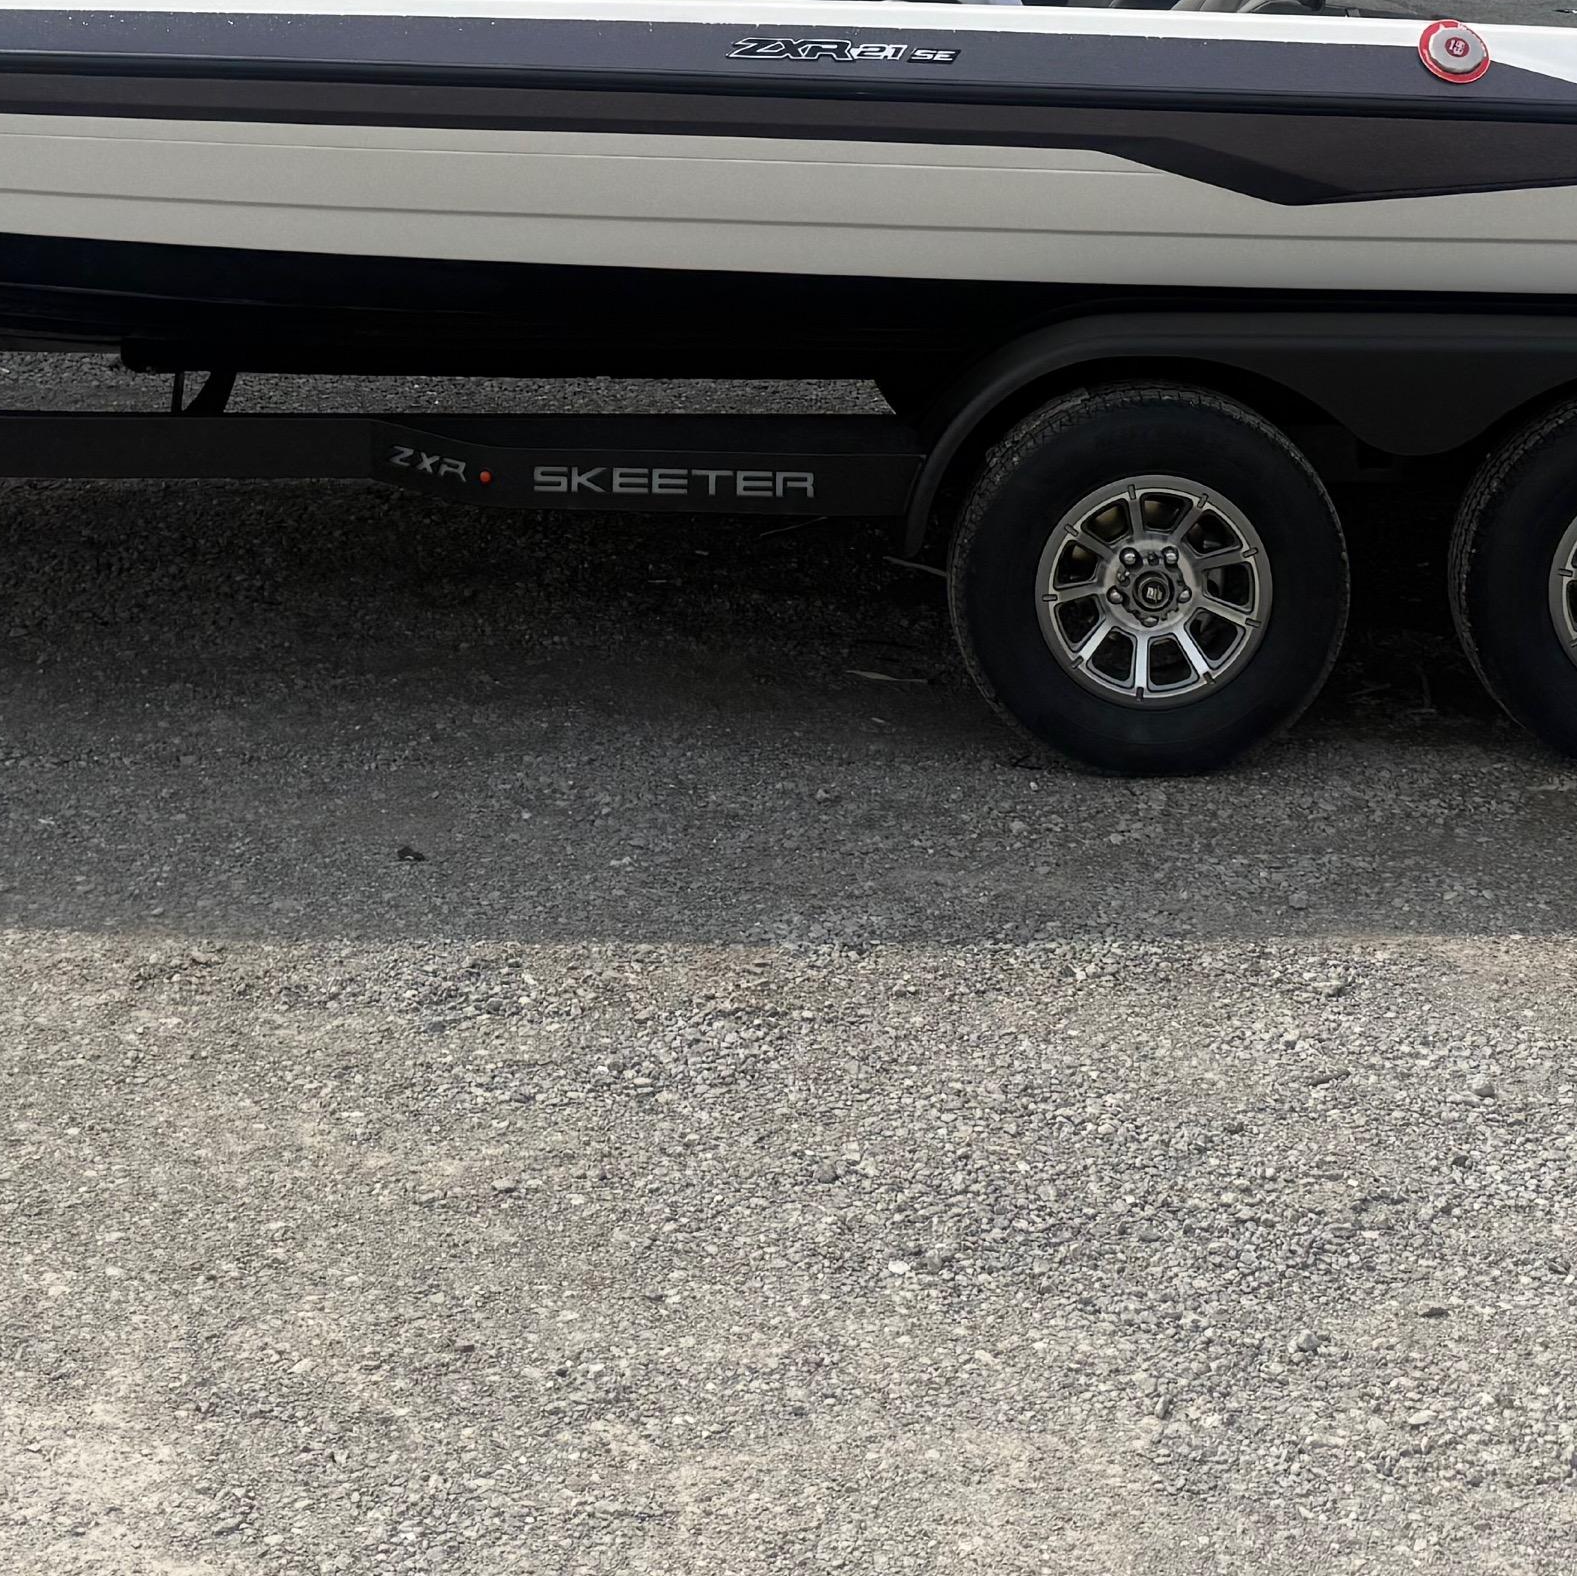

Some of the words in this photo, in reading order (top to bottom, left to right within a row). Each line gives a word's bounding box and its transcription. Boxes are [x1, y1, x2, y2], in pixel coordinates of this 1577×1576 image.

[727, 37, 854, 62] ZXR
[912, 50, 956, 62] SE
[388, 445, 467, 482] ZXR
[533, 465, 815, 498] SKEETER
